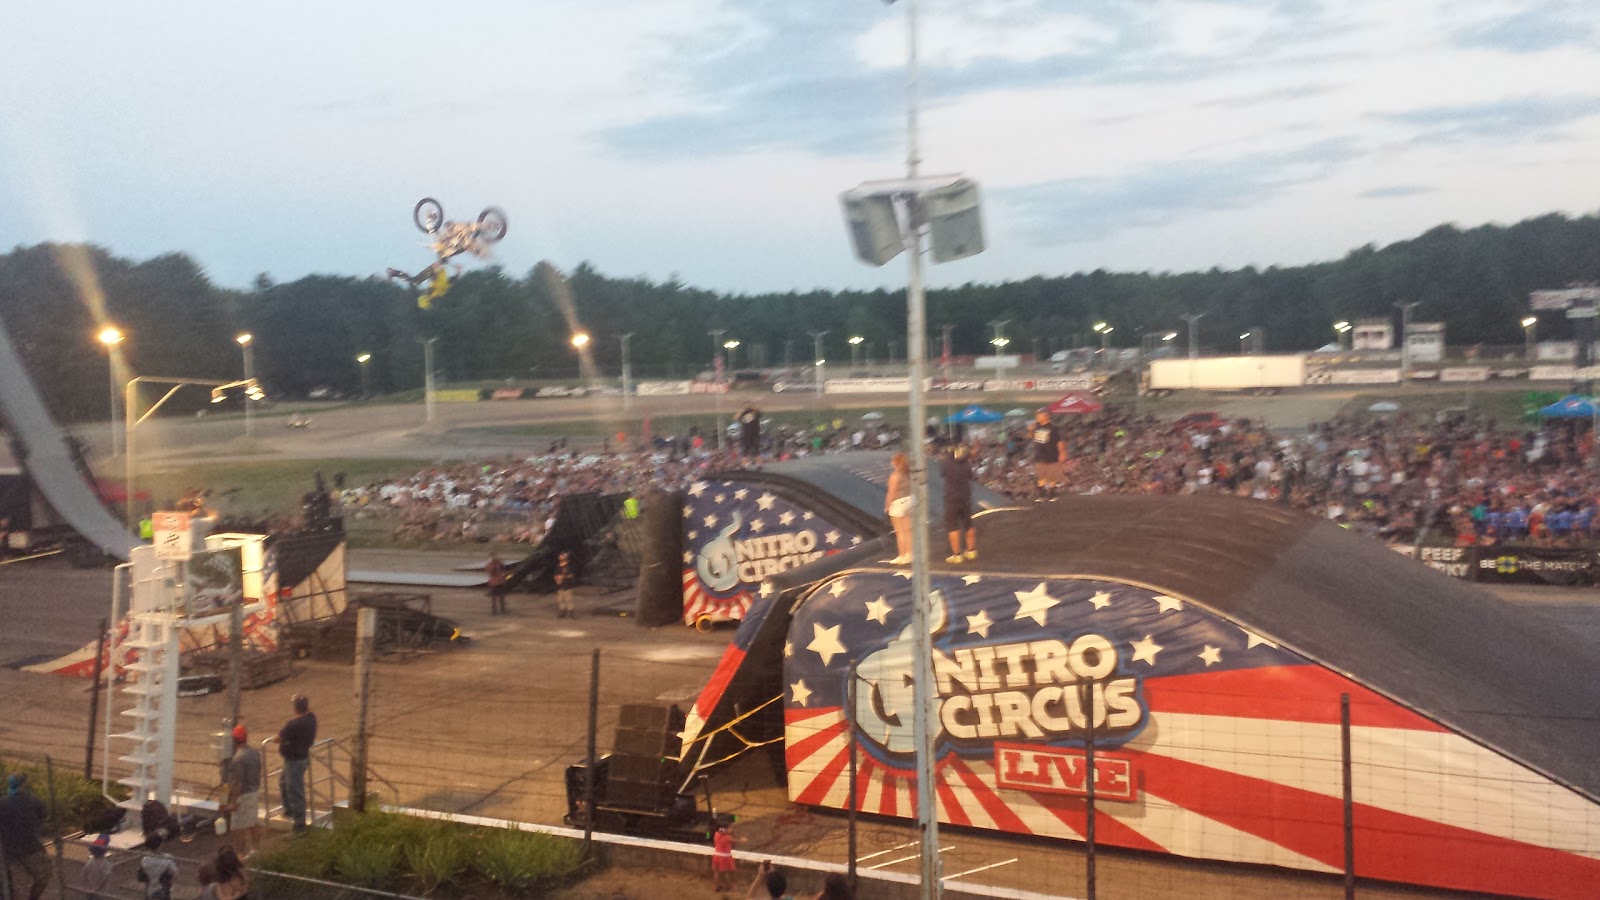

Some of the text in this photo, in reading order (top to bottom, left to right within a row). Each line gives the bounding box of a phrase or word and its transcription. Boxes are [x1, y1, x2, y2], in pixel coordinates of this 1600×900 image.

[735, 530, 817, 562] NITRO
[1480, 559, 1497, 569] BE
[1518, 560, 1541, 571] THE
[932, 634, 1117, 693] NITRO
[941, 678, 1141, 738] CIRCUS
[1005, 751, 1127, 793] LIVE
